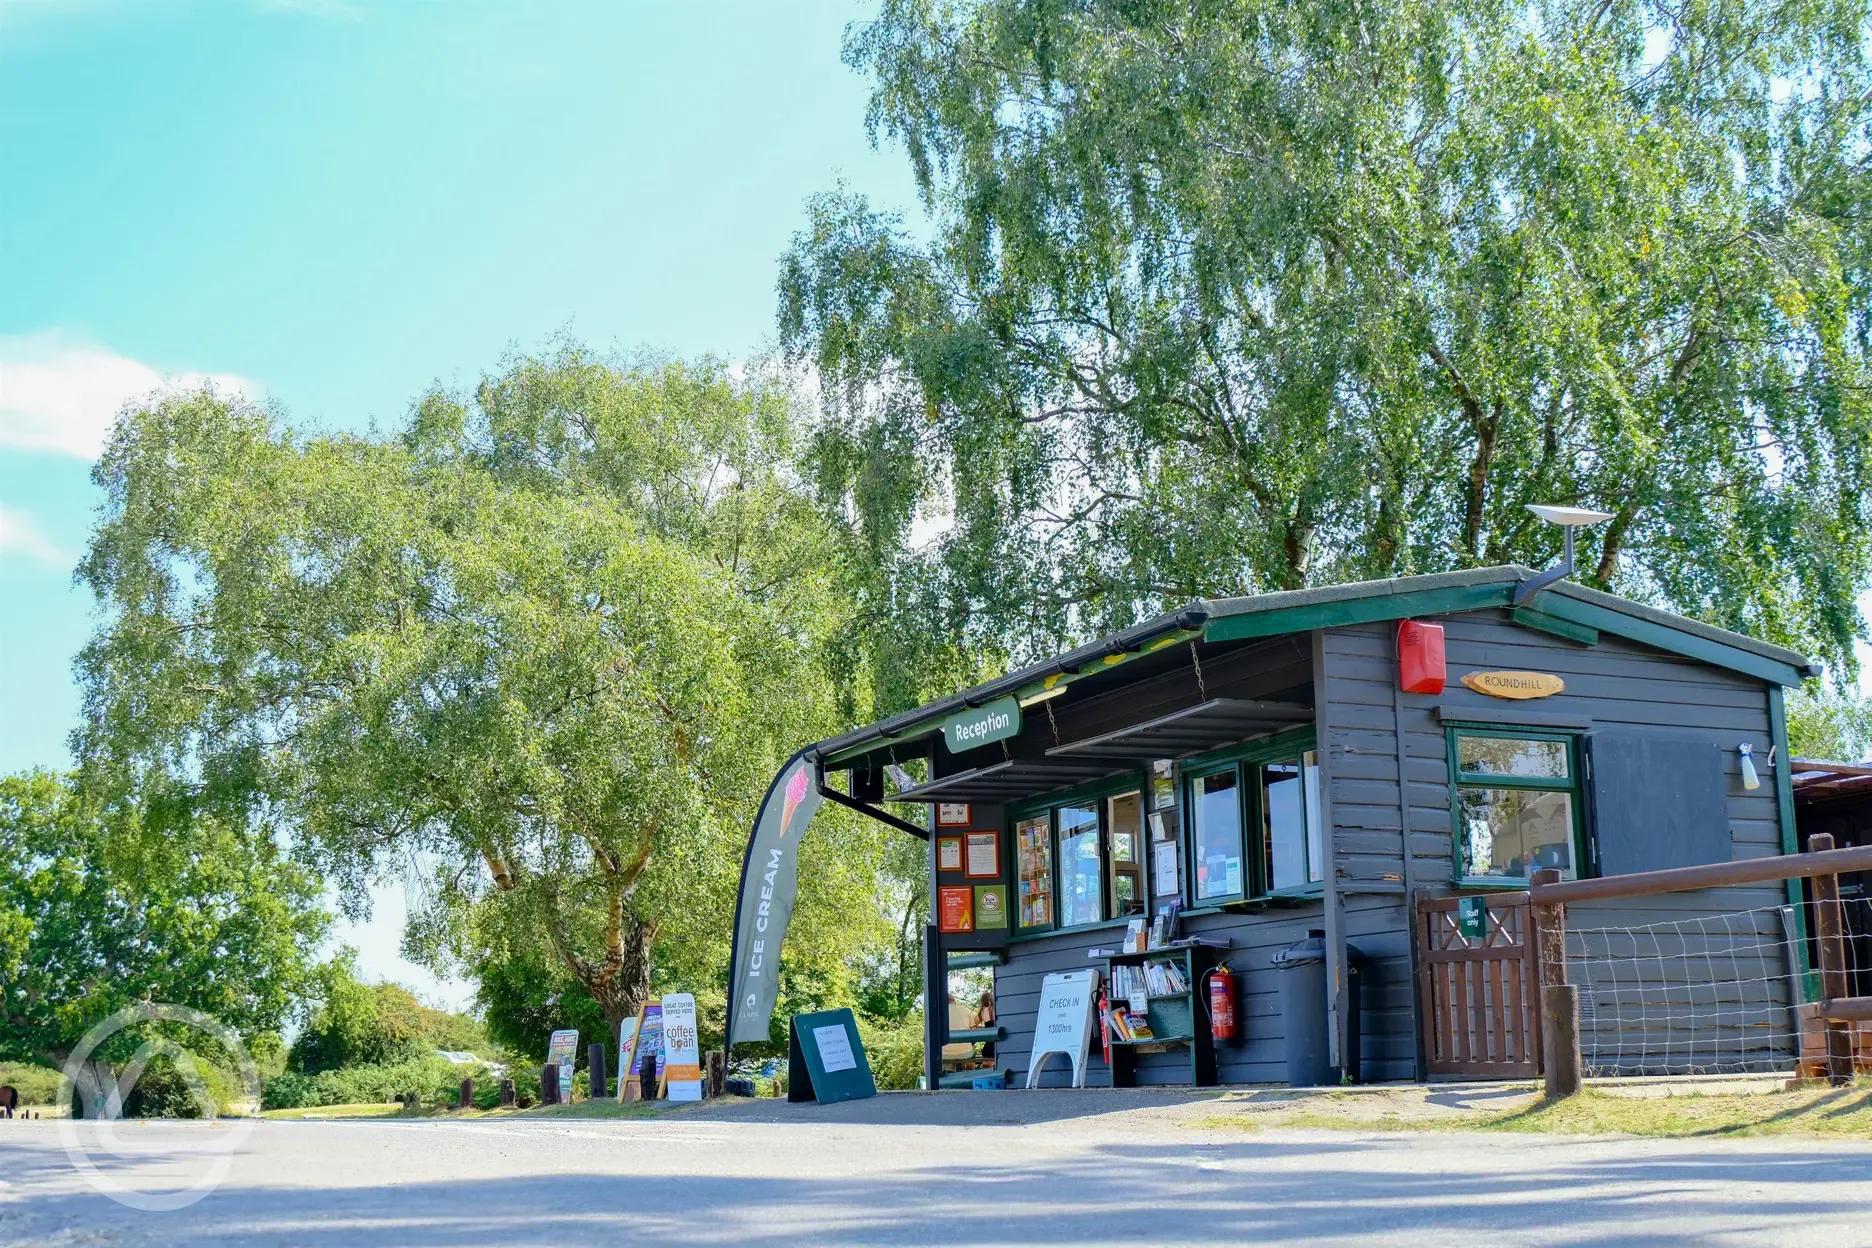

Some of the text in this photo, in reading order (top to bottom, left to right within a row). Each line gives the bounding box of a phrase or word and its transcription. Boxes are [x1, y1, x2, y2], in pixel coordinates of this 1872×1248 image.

[1484, 675, 1543, 690] ROUNDHILL
[955, 712, 1010, 742] Reception
[749, 848, 783, 977] ICE CREAM
[1466, 908, 1479, 918] Staff
[1466, 918, 1479, 928] only
[1049, 996, 1080, 1009] CHECK IN
[666, 1025, 694, 1039] coffee
[1048, 1023, 1072, 1034] 1300hrs
